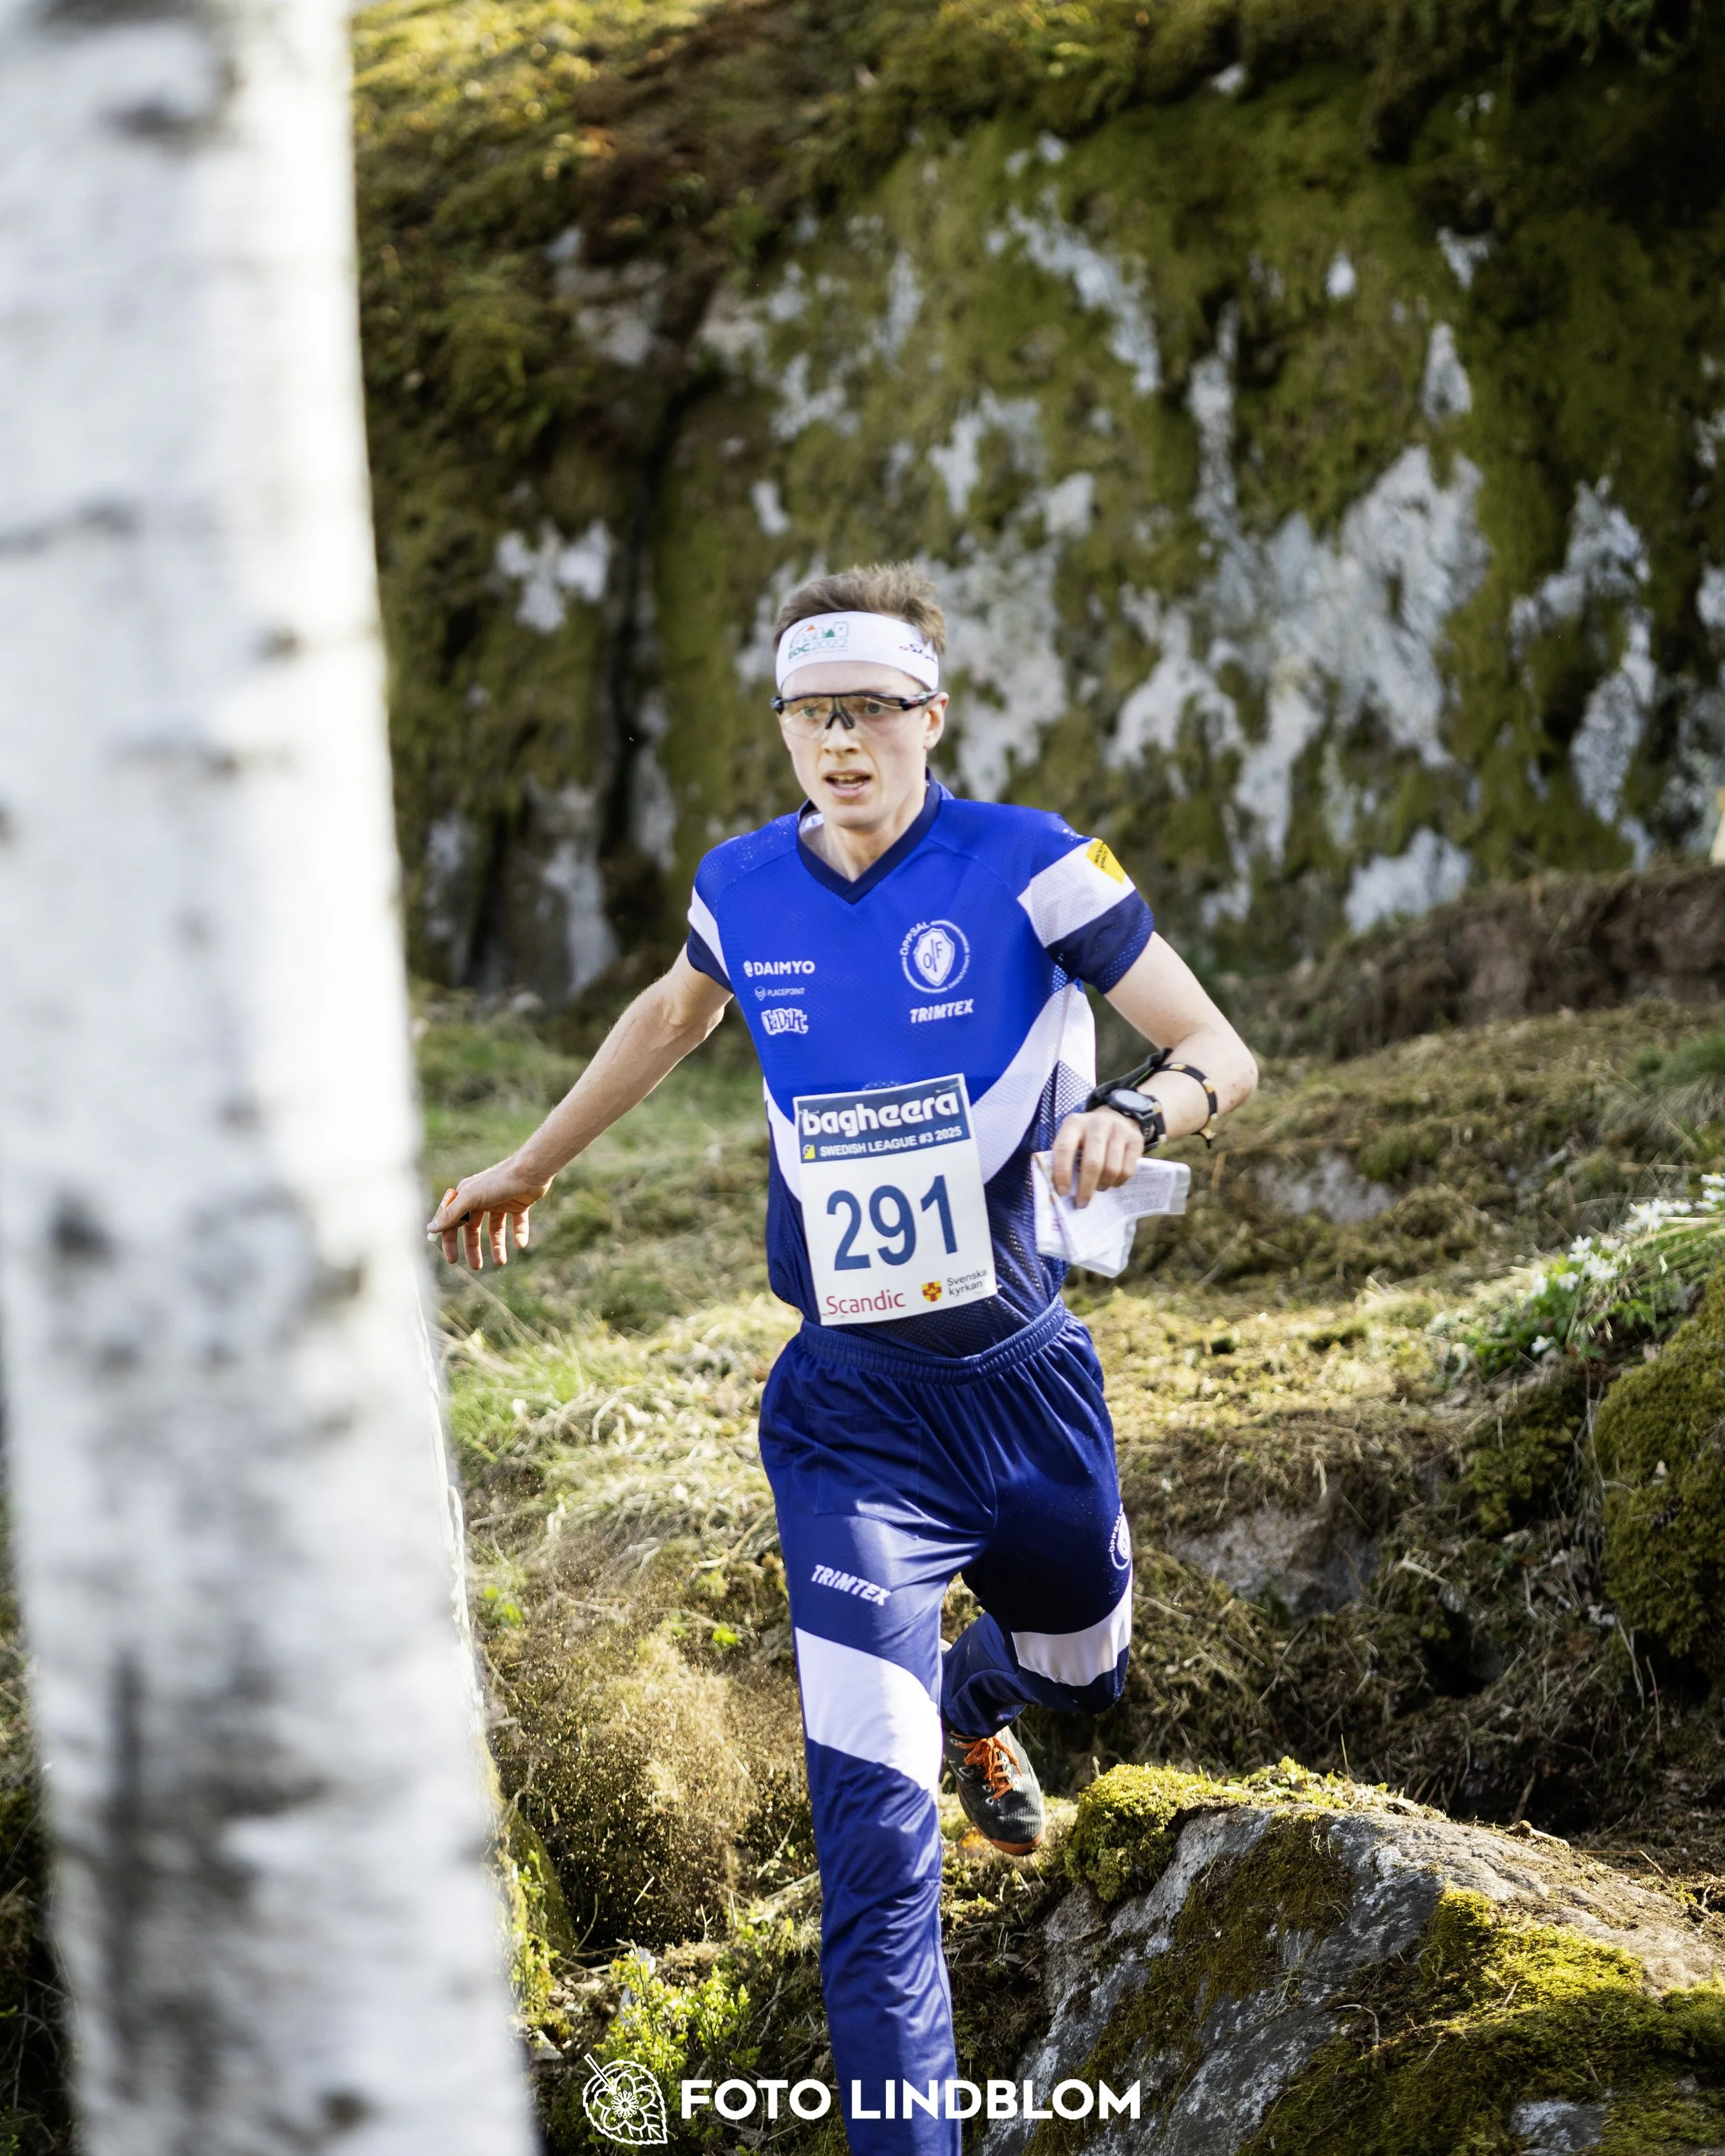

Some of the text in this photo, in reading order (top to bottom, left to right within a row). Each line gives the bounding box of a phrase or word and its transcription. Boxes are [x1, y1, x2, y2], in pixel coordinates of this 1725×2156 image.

[899, 921, 931, 956] OPPSAL
[753, 960, 816, 976] DAIMYO
[767, 987, 805, 997] PLACEPOINT
[909, 998, 974, 1024] TRIMTEX
[802, 1092, 960, 1137] bagheera
[820, 1125, 962, 1157] SWEDISH LEAGUE #3 2025
[827, 1174, 958, 1271] 291
[947, 1269, 987, 1286] Svenska
[949, 1280, 983, 1297] kyrkan
[826, 1289, 906, 1314] Scandic
[811, 1564, 891, 1606] TRIMTEX
